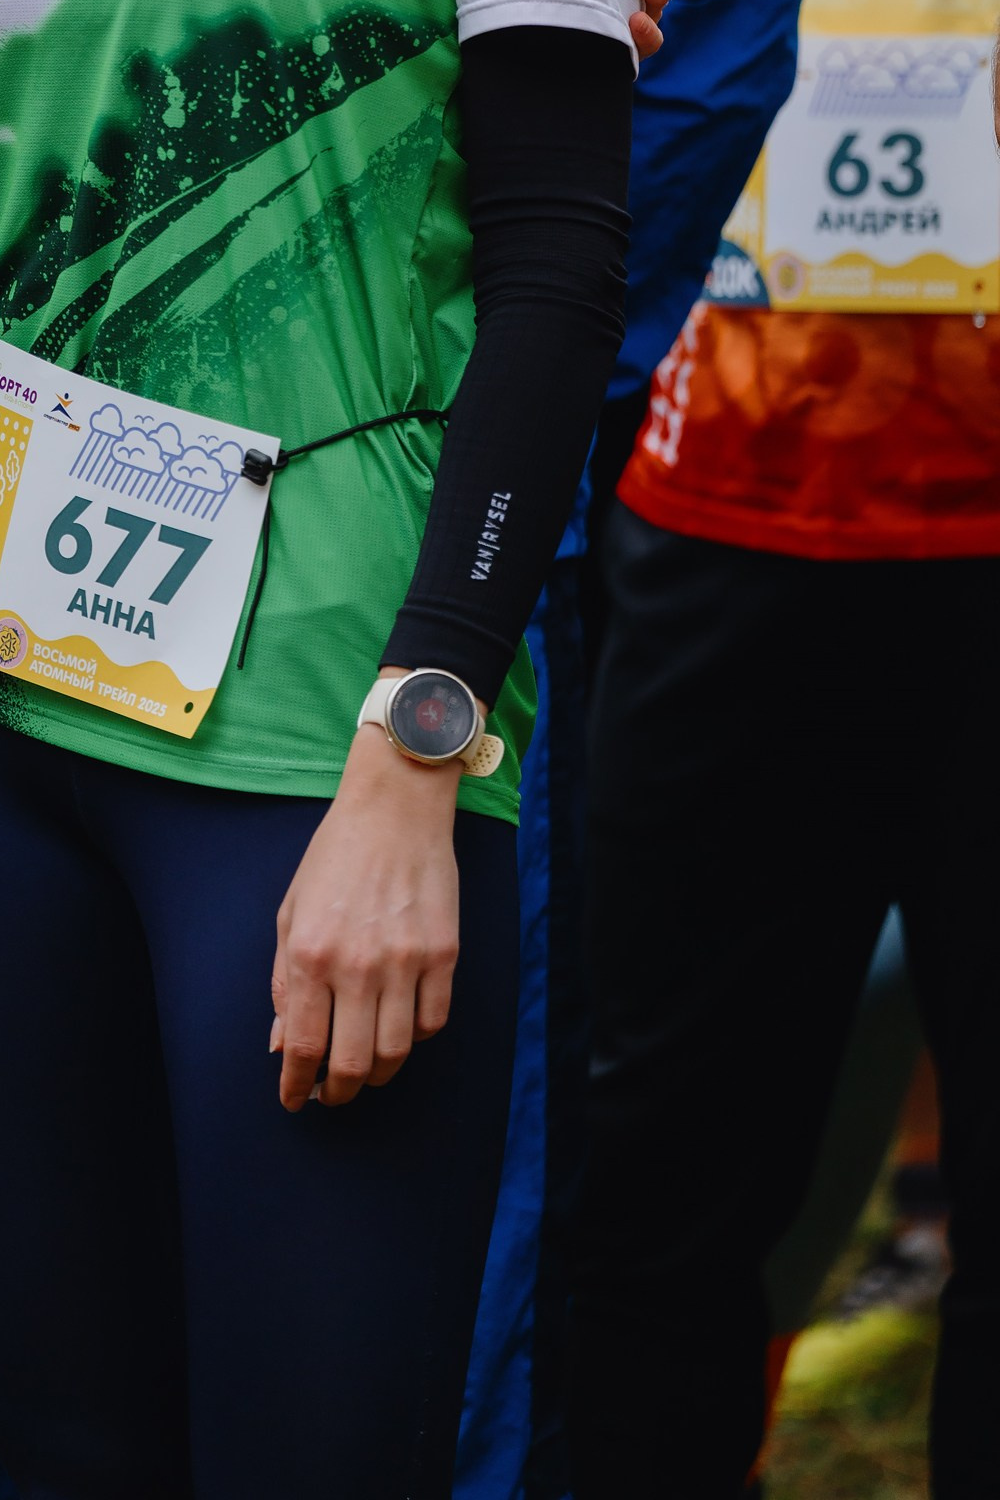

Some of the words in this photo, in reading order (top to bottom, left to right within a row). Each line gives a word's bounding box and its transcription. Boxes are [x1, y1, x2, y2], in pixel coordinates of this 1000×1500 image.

[827, 131, 925, 198] 63
[816, 204, 942, 236] АНДРЕЙ
[22, 387, 37, 404] 40
[45, 495, 213, 606] 677
[66, 587, 157, 640] АННА
[33, 643, 97, 675] ВОСЬМОЙ
[29, 659, 95, 692] АТОМНЫЙ
[97, 682, 136, 706] ТРЕЙЛ
[137, 696, 168, 717] 2025
